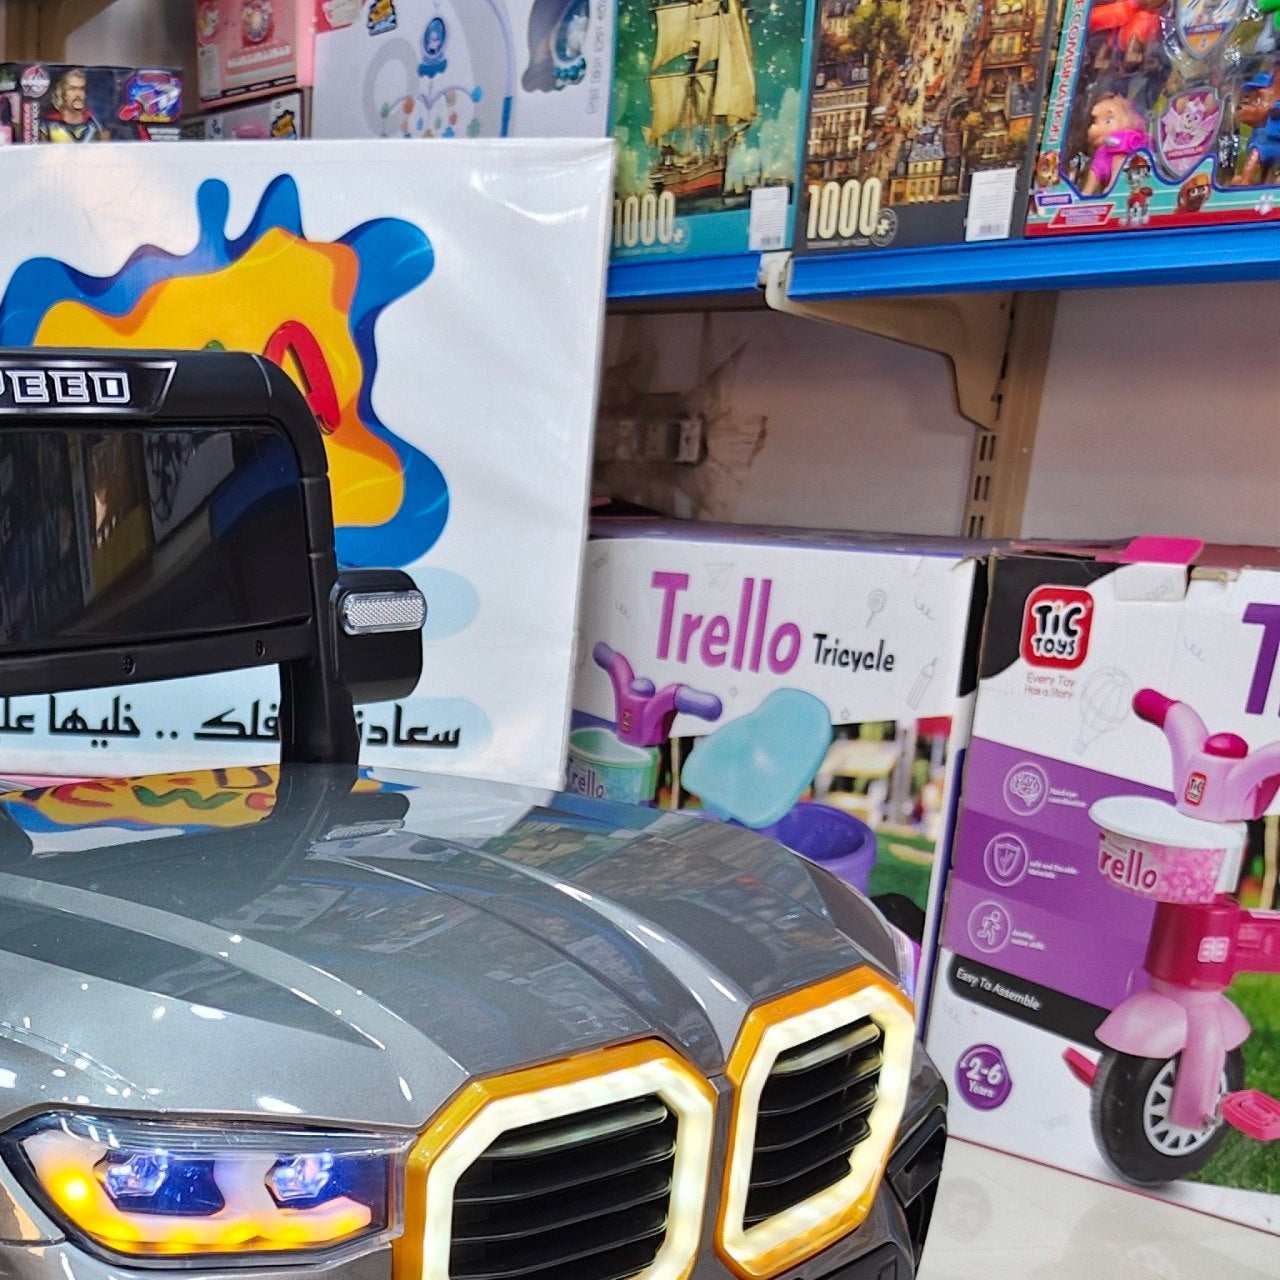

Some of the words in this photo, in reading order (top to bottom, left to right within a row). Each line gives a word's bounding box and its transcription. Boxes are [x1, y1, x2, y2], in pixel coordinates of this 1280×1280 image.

[614, 190, 676, 247] 1000
[806, 177, 883, 239] 1000
[650, 570, 802, 675] Trello
[812, 631, 895, 674] Tricycle
[48, 694, 141, 748] خليها
[955, 966, 978, 988] Easy
[979, 977, 992, 991] To
[991, 981, 1042, 1012] Assemble
[965, 1056, 1003, 1086] 2-6
[968, 1079, 995, 1099] Years
